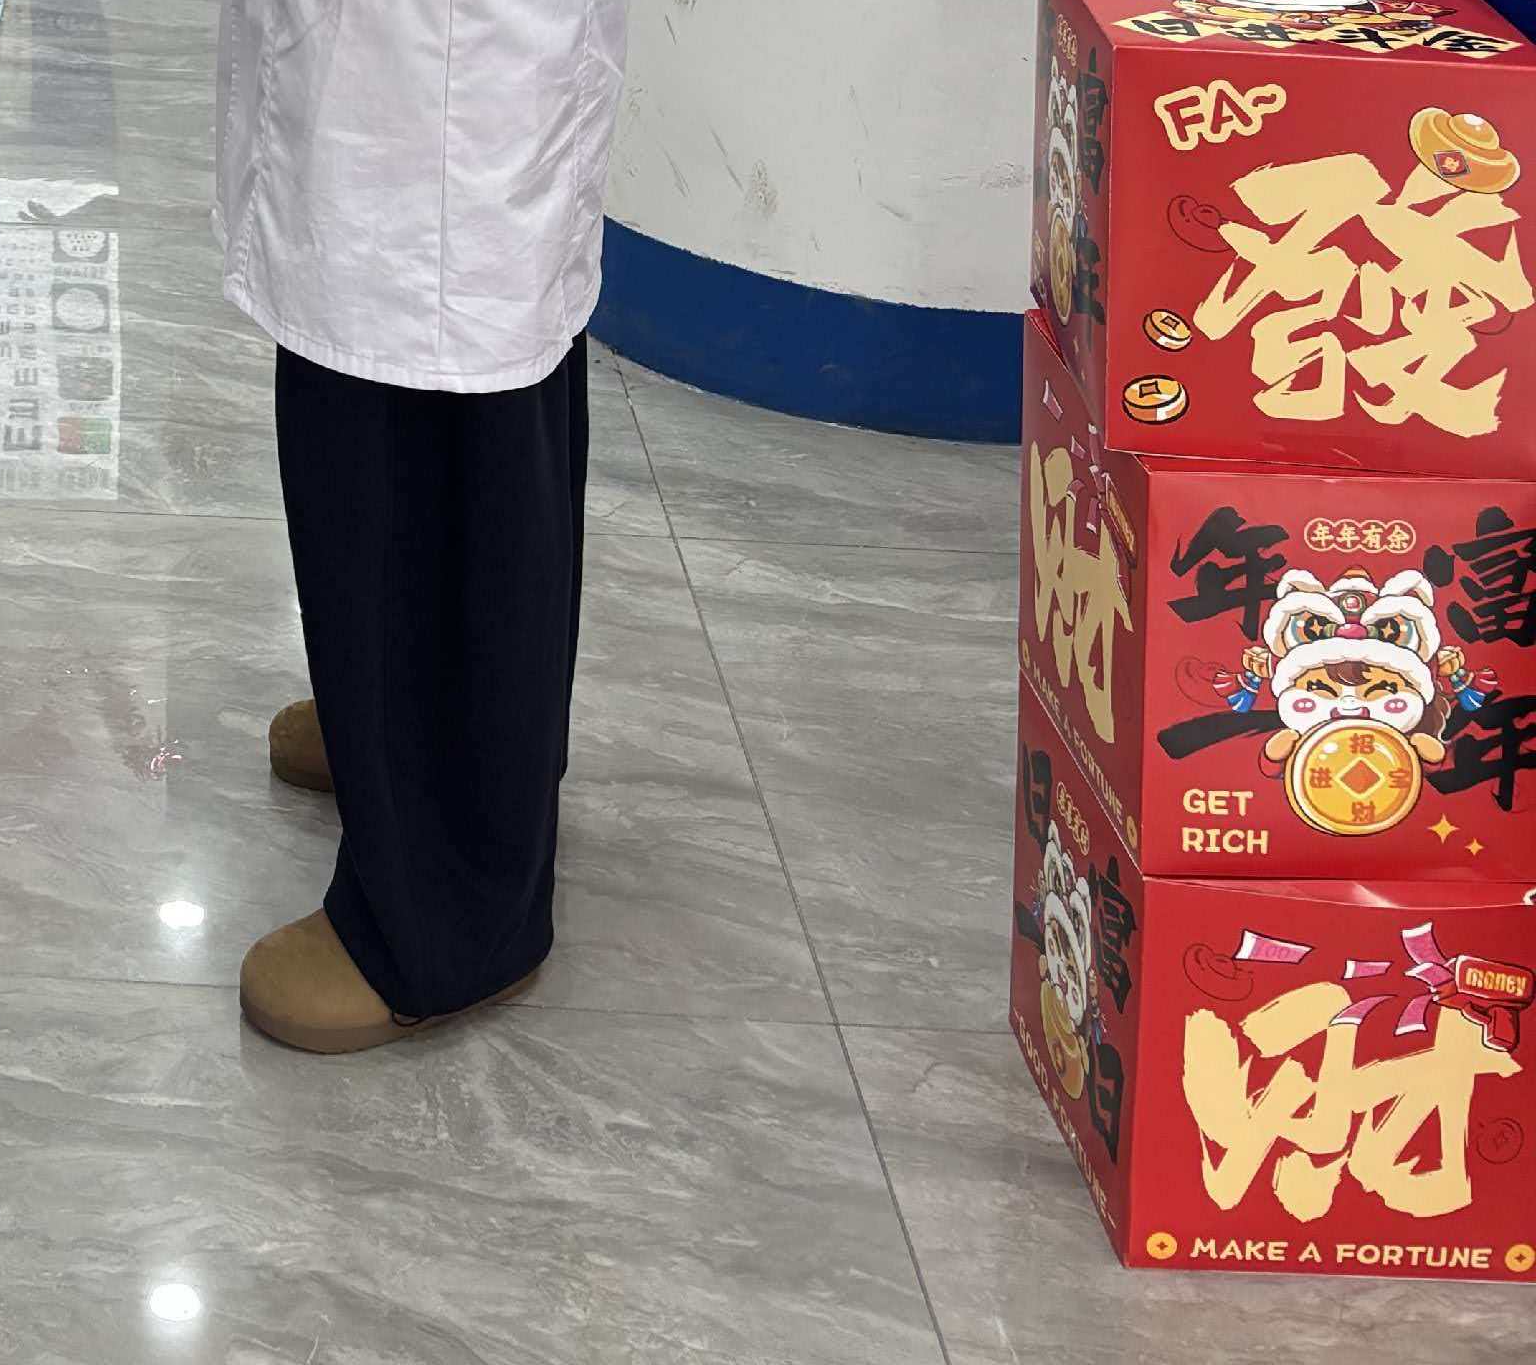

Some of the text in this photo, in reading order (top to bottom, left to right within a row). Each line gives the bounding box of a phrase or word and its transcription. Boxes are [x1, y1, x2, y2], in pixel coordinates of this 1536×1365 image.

[1308, 521, 1412, 550] 年年有余
[1349, 732, 1376, 754] 招
[1182, 788, 1254, 817] GET
[1350, 801, 1377, 821] 财
[1181, 827, 1269, 855] RICH
[1465, 967, 1527, 997] money
[1183, 981, 1524, 1224] 财
[1190, 1237, 1492, 1269] MAKE A FORTUNE
